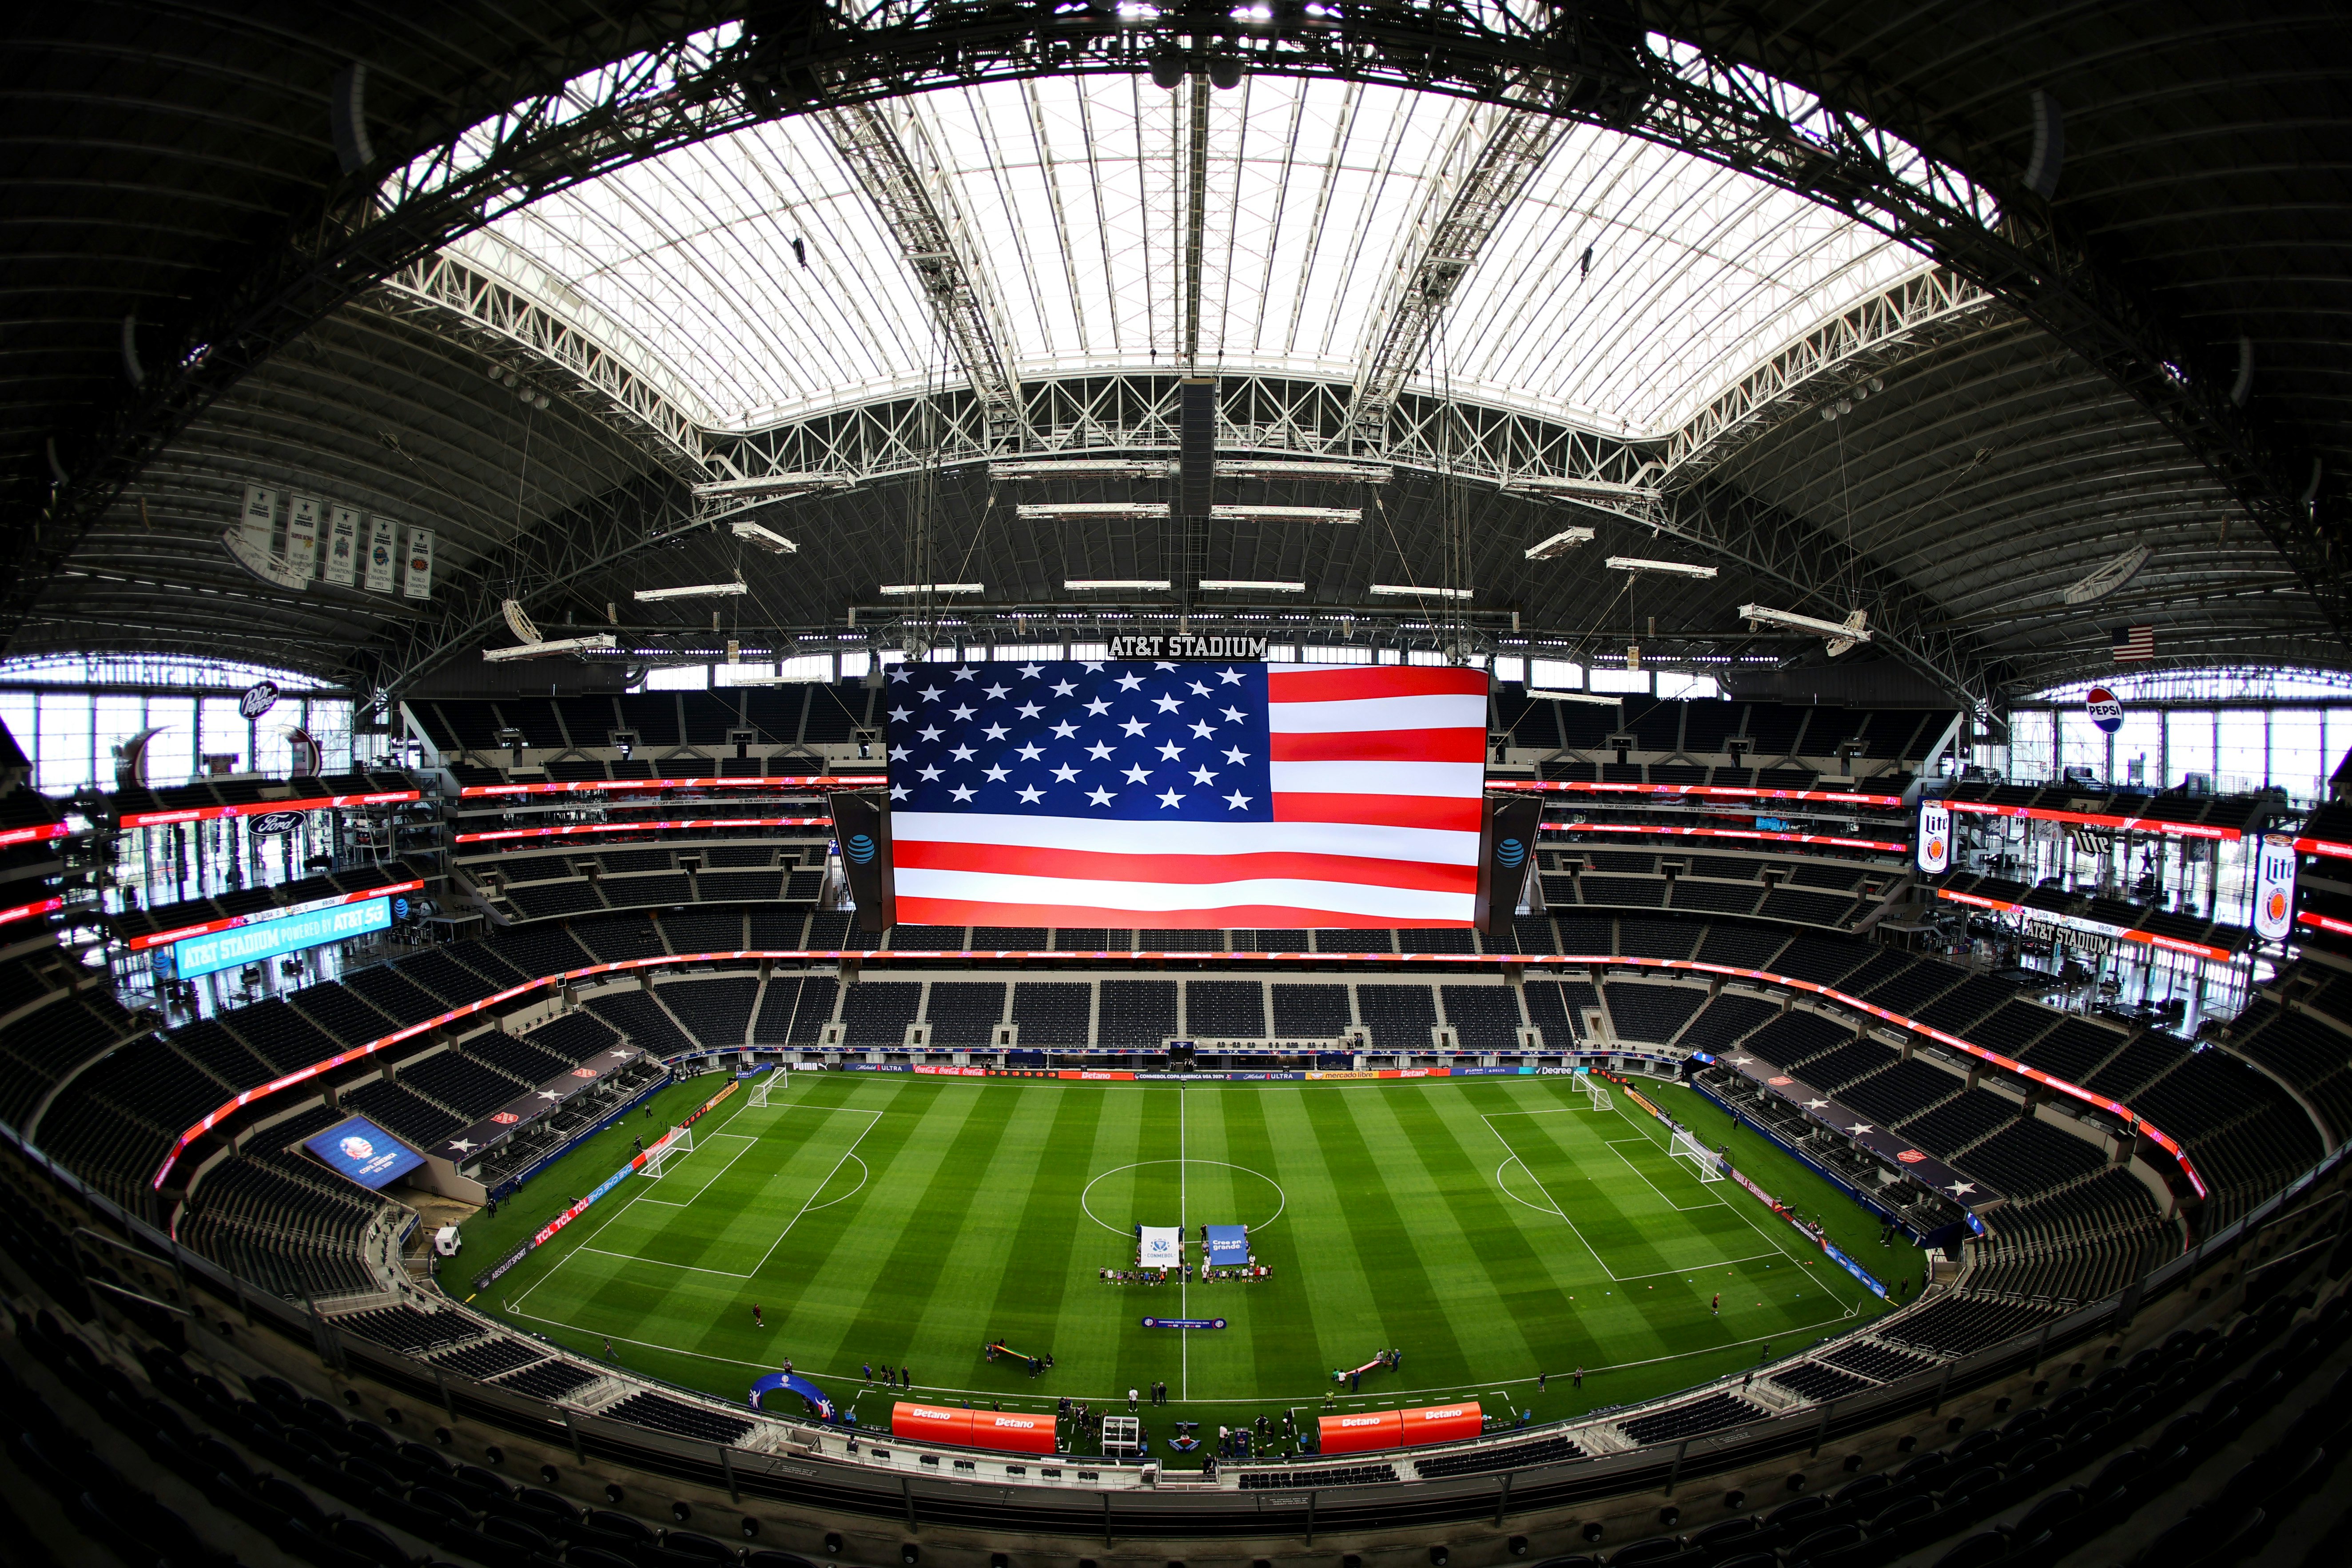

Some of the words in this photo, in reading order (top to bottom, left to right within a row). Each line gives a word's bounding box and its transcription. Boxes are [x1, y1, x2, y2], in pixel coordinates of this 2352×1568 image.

[328, 565, 353, 575] CHAMPIONS
[368, 573, 391, 582] CHAMPIONS
[1109, 636, 1163, 656] AT&T
[1169, 637, 1267, 657] STADIUM
[257, 685, 272, 698] Dr
[247, 688, 277, 715] Pepper
[2089, 705, 2120, 716] PEPSI
[364, 794, 408, 803] store.copaamerica.com
[1954, 803, 1998, 812] store.copaamerica.com
[258, 814, 293, 832] Ford
[1925, 814, 1948, 835] Lite
[2162, 824, 2221, 836] store.copaamerica.com
[2070, 830, 2110, 858] Lite
[2265, 855, 2294, 885] Lite
[369, 883, 412, 896] store.copaamerica.com
[1949, 893, 1992, 906] store.copaamerica.com
[184, 942, 218, 968] AT&T
[220, 928, 280, 960] STADIUM
[281, 919, 320, 943] POWERED
[322, 918, 332, 932] BY
[333, 909, 364, 931] AT&T
[364, 905, 384, 924] 5G
[2026, 921, 2055, 941] AT&T
[2056, 928, 2110, 955] STADIUM
[2153, 937, 2211, 955] store.copaamerica.com
[1401, 1068, 1429, 1077] Betano
[2046, 1078, 2091, 1099] store.copaamerica.com
[645, 1142, 661, 1159] Betano
[359, 1165, 375, 1174] COPA
[373, 1153, 398, 1166] AMERICA
[1711, 1153, 1724, 1168] ULTRA
[1732, 1170, 1747, 1189] TEQUILA
[1748, 1182, 1773, 1207] CENTENARIO
[573, 1199, 589, 1214] TCL
[555, 1213, 572, 1230] TCL
[536, 1227, 553, 1244] TCL
[492, 1259, 512, 1281] ABSOLUT
[512, 1247, 526, 1265] SPORT
[913, 1408, 951, 1420] Betano
[1342, 1417, 1380, 1427] Betano
[1425, 1409, 1462, 1420] Betano
[995, 1417, 1034, 1429] Betano
